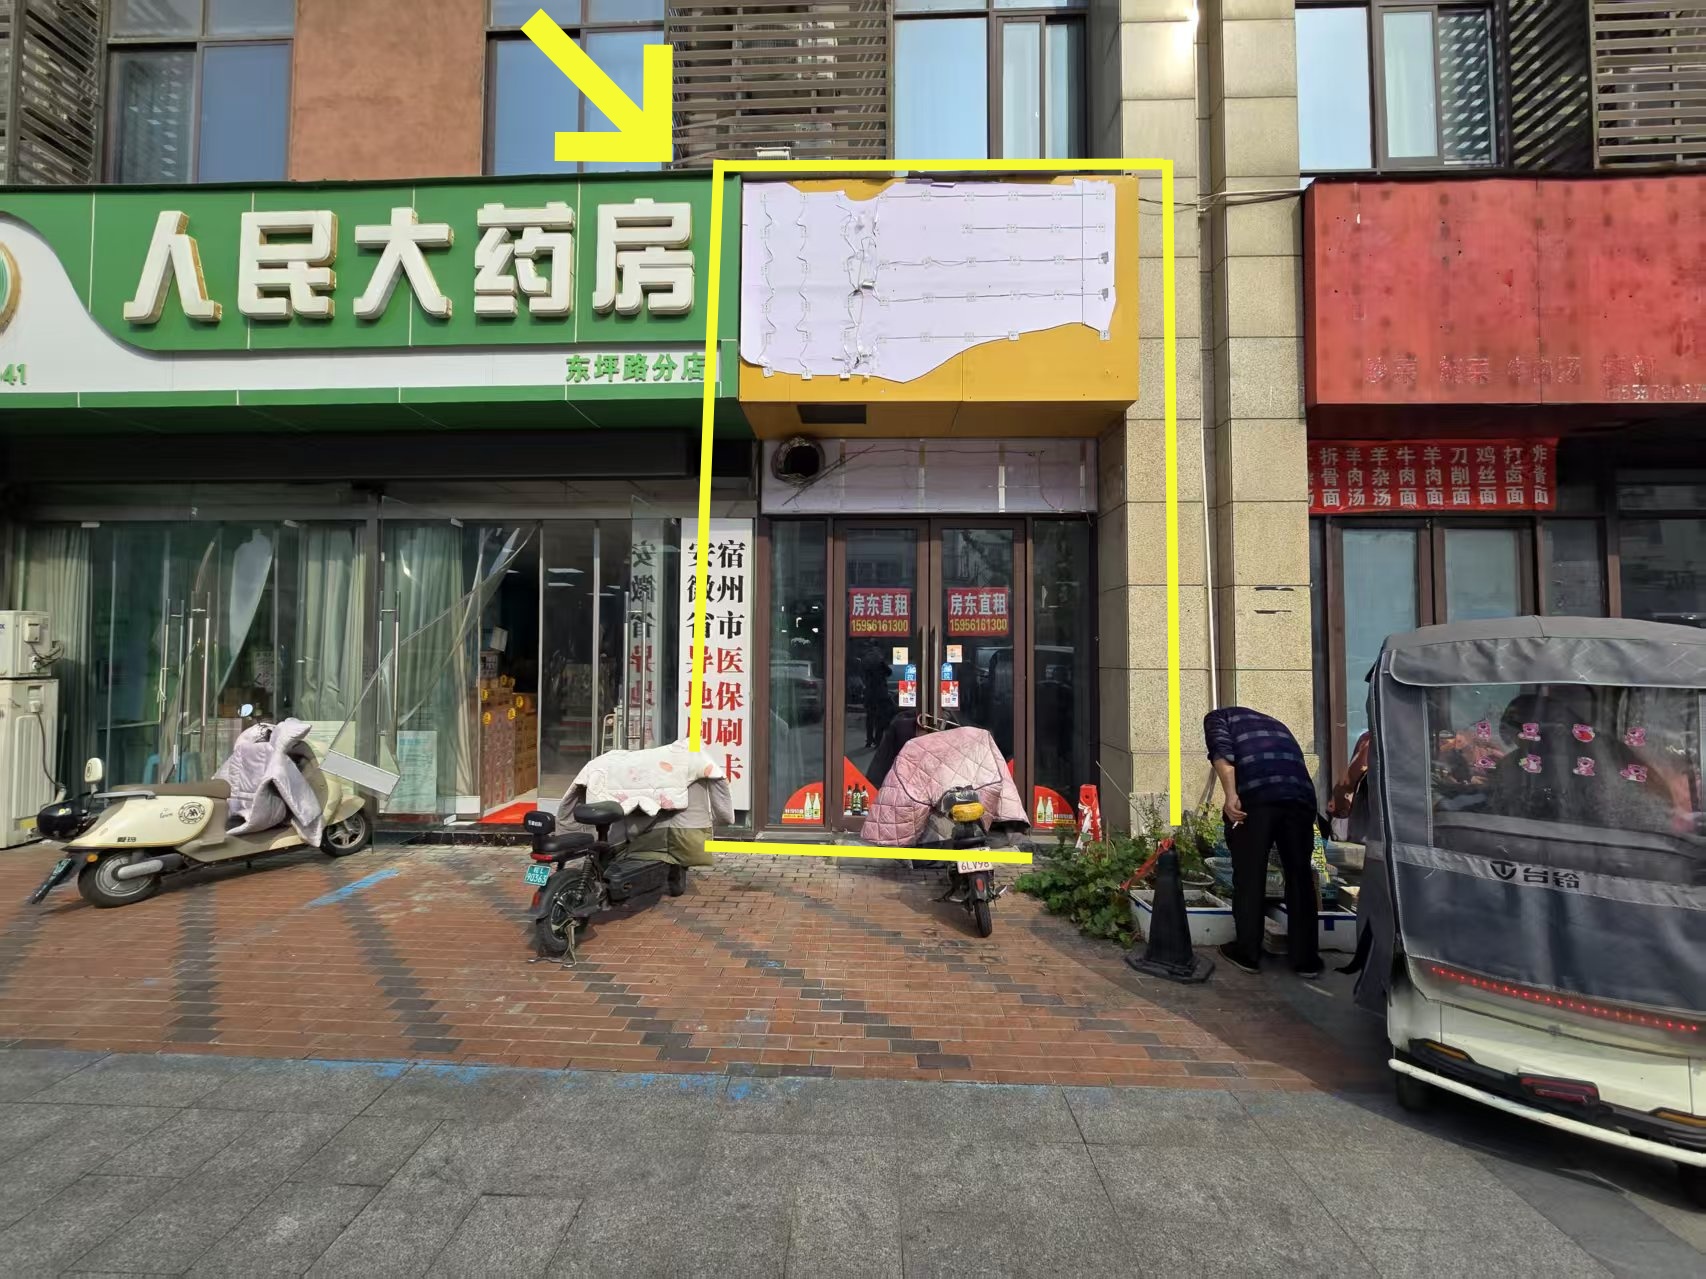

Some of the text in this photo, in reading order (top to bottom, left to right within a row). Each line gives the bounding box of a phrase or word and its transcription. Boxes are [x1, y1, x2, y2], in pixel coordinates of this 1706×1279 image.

[123, 198, 696, 325] 人民大药房
[564, 351, 708, 384] 东坪路分店
[1345, 447, 1366, 506] 羊肉汤
[1370, 447, 1391, 506] 羊杂汤
[1396, 447, 1417, 505] 牛肉面
[1423, 446, 1444, 505] 羊肉面
[1450, 447, 1471, 505] 刀削面
[1476, 447, 1497, 505] 鸡丝面
[1503, 446, 1525, 504] 打卤面
[851, 618, 908, 633] 15956161300
[852, 593, 909, 616] 房东直租
[950, 592, 1008, 615] 房东直租
[950, 617, 1008, 632] 15956161300
[714, 539, 746, 783] 宿州市医保刷卡
[1523, 867, 1580, 889] 台铃
